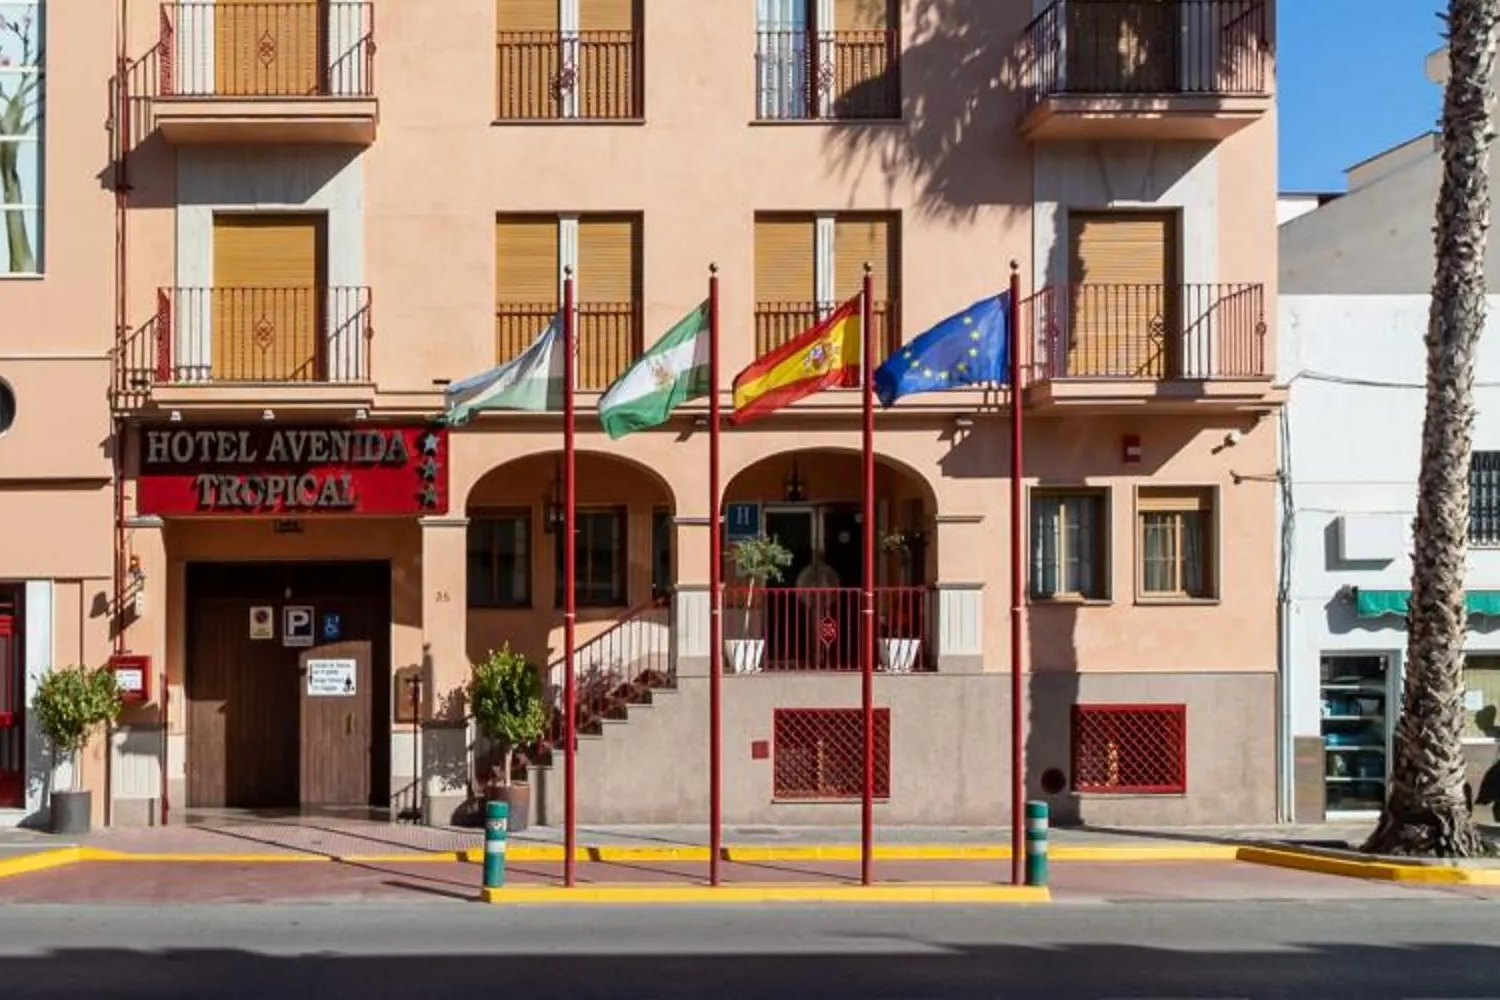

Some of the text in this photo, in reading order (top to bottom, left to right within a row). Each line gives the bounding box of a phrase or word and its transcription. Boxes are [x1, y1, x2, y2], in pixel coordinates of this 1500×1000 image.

[147, 429, 409, 463] HOTEL AVENIDA
[196, 473, 356, 506] TROPICAL
[736, 506, 750, 526] H
[288, 611, 309, 634] P
